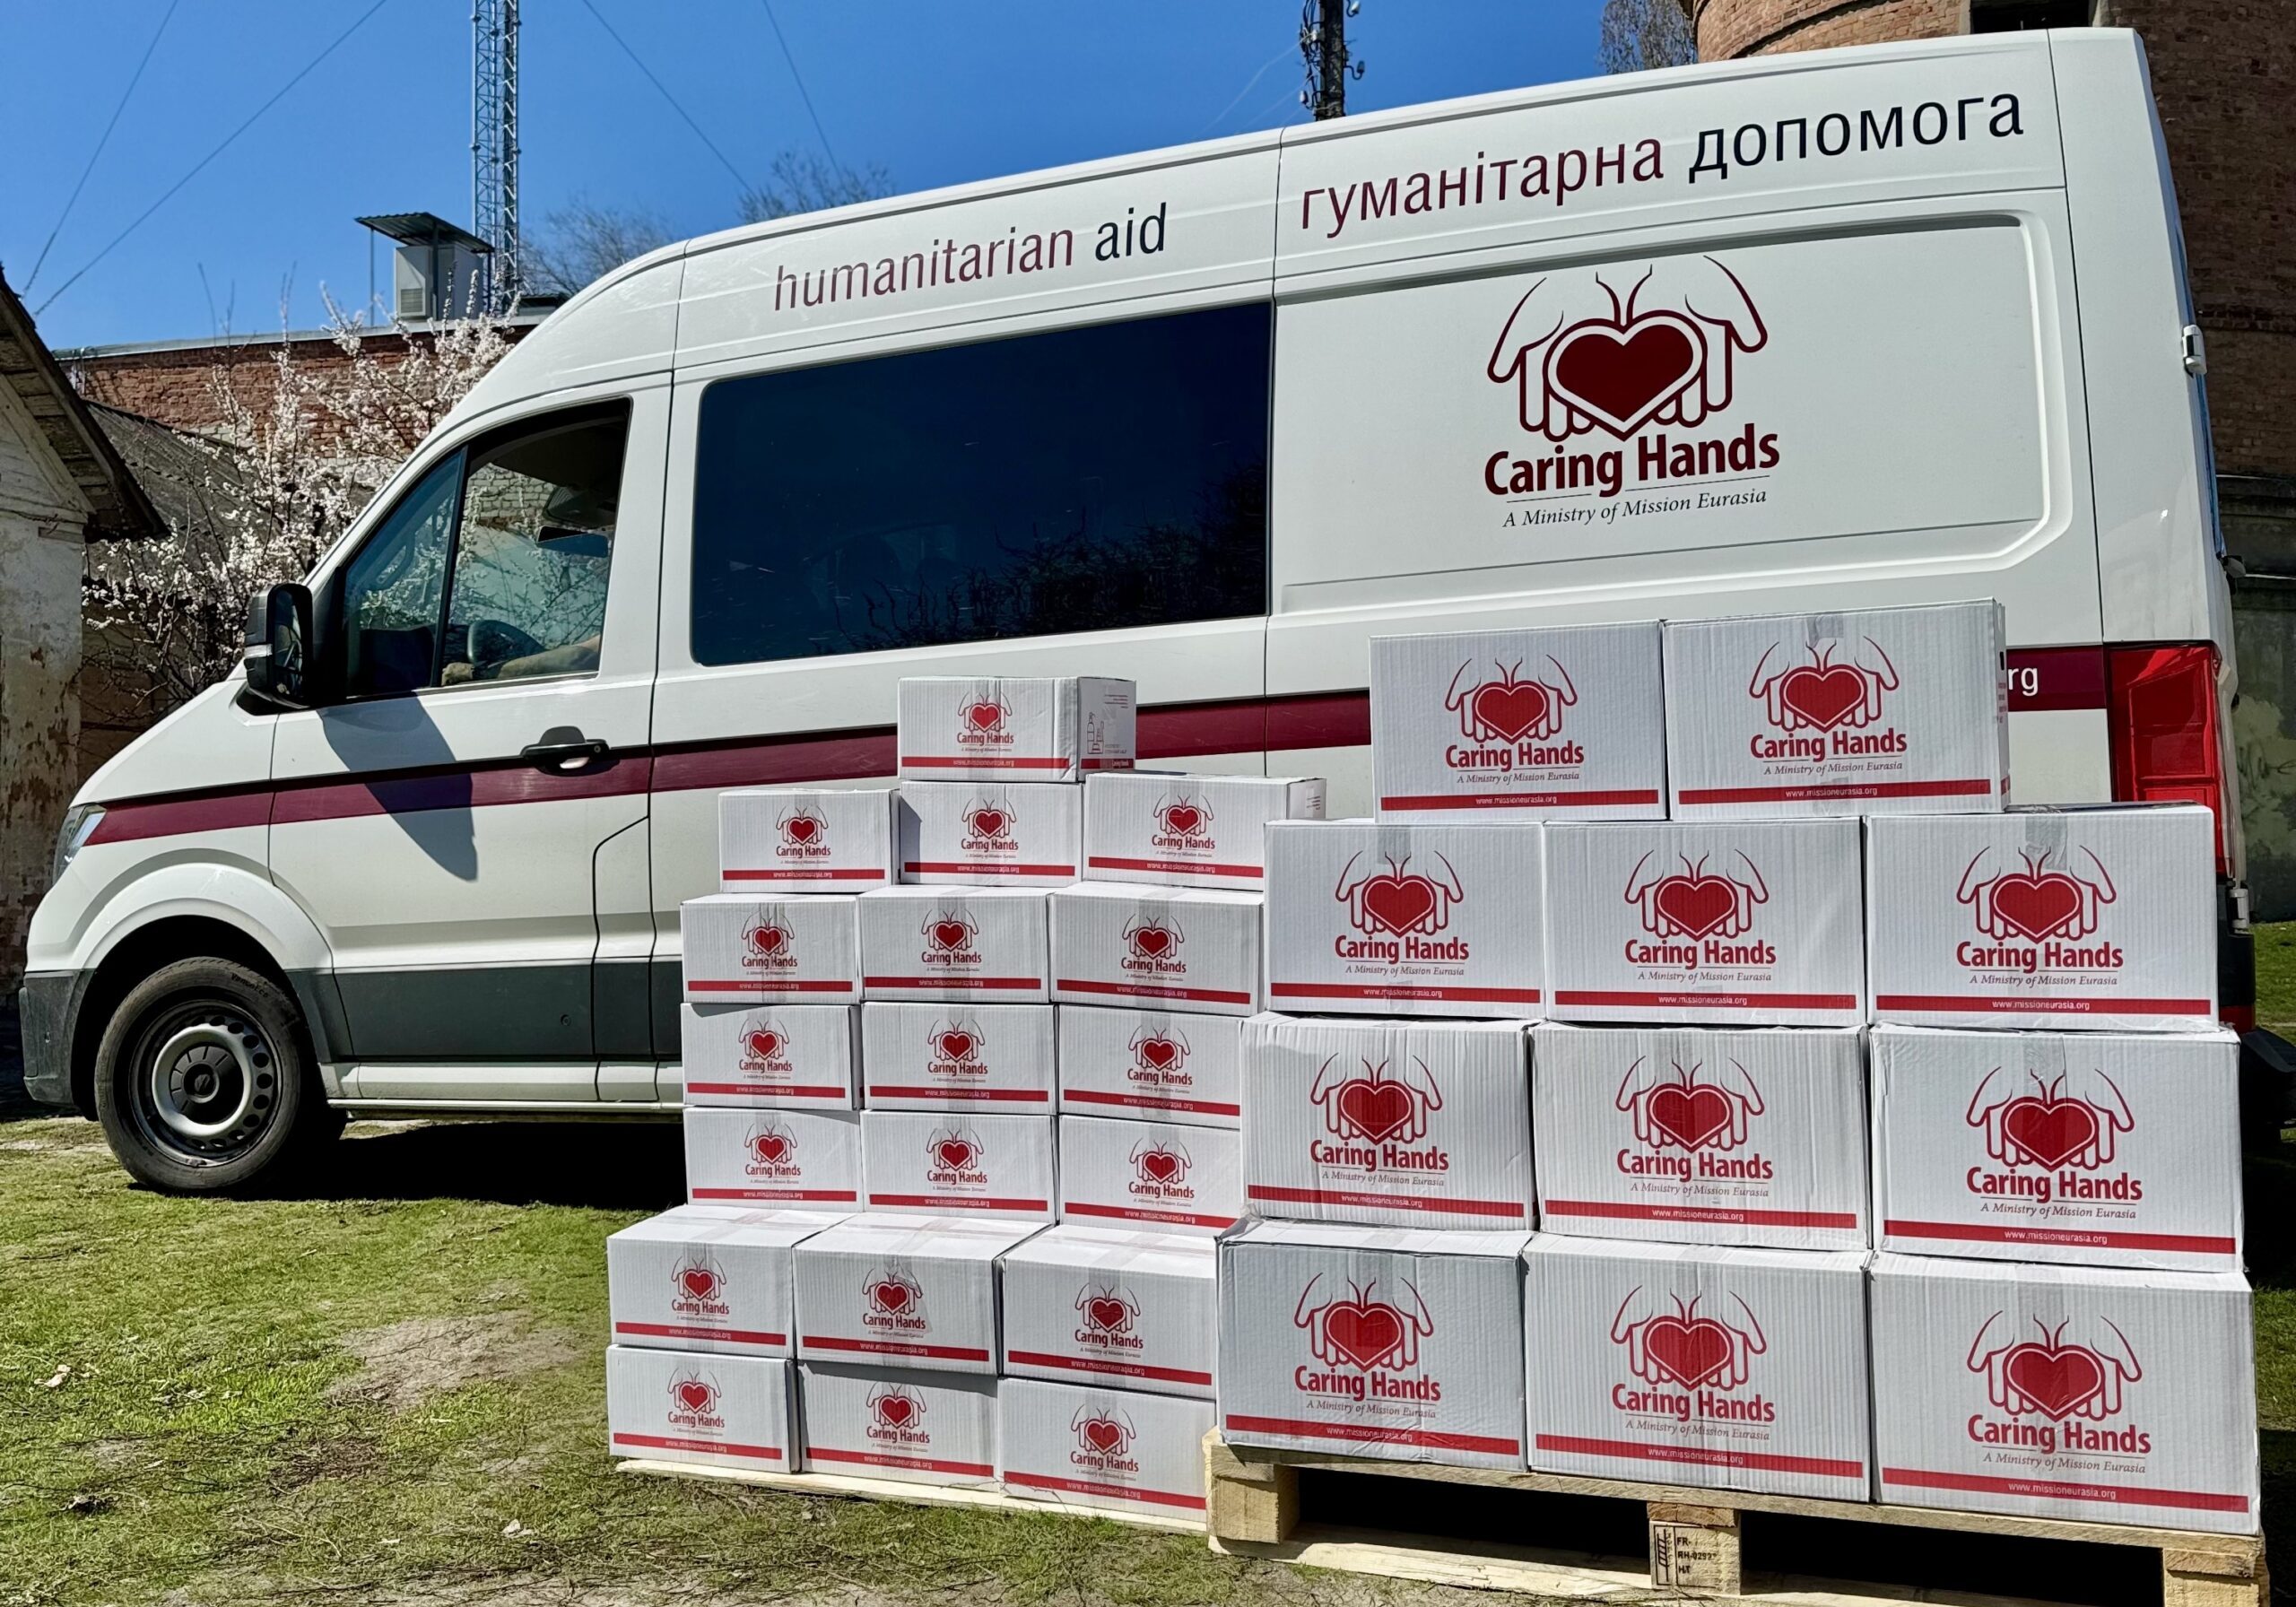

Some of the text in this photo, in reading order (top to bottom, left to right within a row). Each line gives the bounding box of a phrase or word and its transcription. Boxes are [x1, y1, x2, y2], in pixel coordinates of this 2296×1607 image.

[1301, 92, 2024, 239] гуманітарна допомога
[774, 202, 1167, 312] humanitarian aid
[1484, 422, 1780, 498] Caring Hands
[1501, 488, 1767, 528] A Ministry of Mission Eurasia
[957, 733, 1014, 747] Caring Hands
[1750, 727, 1908, 762] Caring Hands
[1446, 740, 1585, 772] Caring Hands
[1763, 760, 1903, 777] A Ministry of Mission Eurasia
[1457, 771, 1580, 786] A Ministry of Mission Eurasia
[1785, 787, 1878, 798] www.missioneurasia.org
[961, 838, 1019, 854] Caring Hands
[1152, 835, 1216, 851] Caring Hands
[776, 845, 831, 860] Caring Hands
[1335, 934, 1469, 965] Caring Hands
[1624, 939, 1777, 970] Caring Hands
[1956, 941, 2124, 974] Caring Hands
[742, 956, 798, 970] Caring Hands
[921, 951, 982, 967] Caring Hands
[1121, 957, 1187, 975] Caring Hands
[1345, 966, 1465, 978] A Ministry of Mission Eurasia
[1637, 971, 1772, 985] A Ministry of Mission Eurasia
[1970, 975, 2118, 989] A Ministry of Mission Eurasia
[1658, 995, 1747, 1005] www.missioneurasia.org
[1993, 1000, 2091, 1011] www.missioneurasia.org
[739, 1059, 793, 1074] Caring Hands
[927, 1062, 988, 1077] Caring Hands
[1127, 1068, 1193, 1086] Caring Hands
[1310, 1140, 1448, 1172] Caring Hands
[745, 1164, 802, 1179] Caring Hands
[1617, 1148, 1773, 1183] Caring Hands
[927, 1170, 987, 1186] Caring Hands
[1321, 1171, 1444, 1186] A Ministry of Mission Eurasia
[1967, 1167, 2143, 1203] Caring Hands
[1128, 1181, 1195, 1199] Caring Hands
[1630, 1183, 1769, 1198] A Ministry of Mission Eurasia
[1652, 1209, 1744, 1222] www.missioneurasia.org
[1981, 1203, 2137, 1220] A Ministry of Mission Eurasia
[2005, 1231, 2109, 1245] www.missioneurasia.org
[672, 1299, 730, 1316] Caring Hands
[863, 1313, 926, 1331] Caring Hands
[1074, 1329, 1144, 1350] Caring Hands
[1294, 1365, 1441, 1402] Caring Hands
[1307, 1400, 1437, 1419] A Ministry of Mission Eurasia
[1612, 1383, 1775, 1422] Caring Hands
[668, 1412, 726, 1429] Caring Hands
[866, 1426, 930, 1444] Caring Hands
[1625, 1420, 1770, 1440] A Ministry of Mission Eurasia
[1968, 1414, 2152, 1455] Caring Hands
[1070, 1451, 1139, 1472] Caring Hands
[1983, 1453, 2146, 1473] A Ministry of Mission Eurasia
[2008, 1483, 2117, 1500] www.missioneurasia.org
